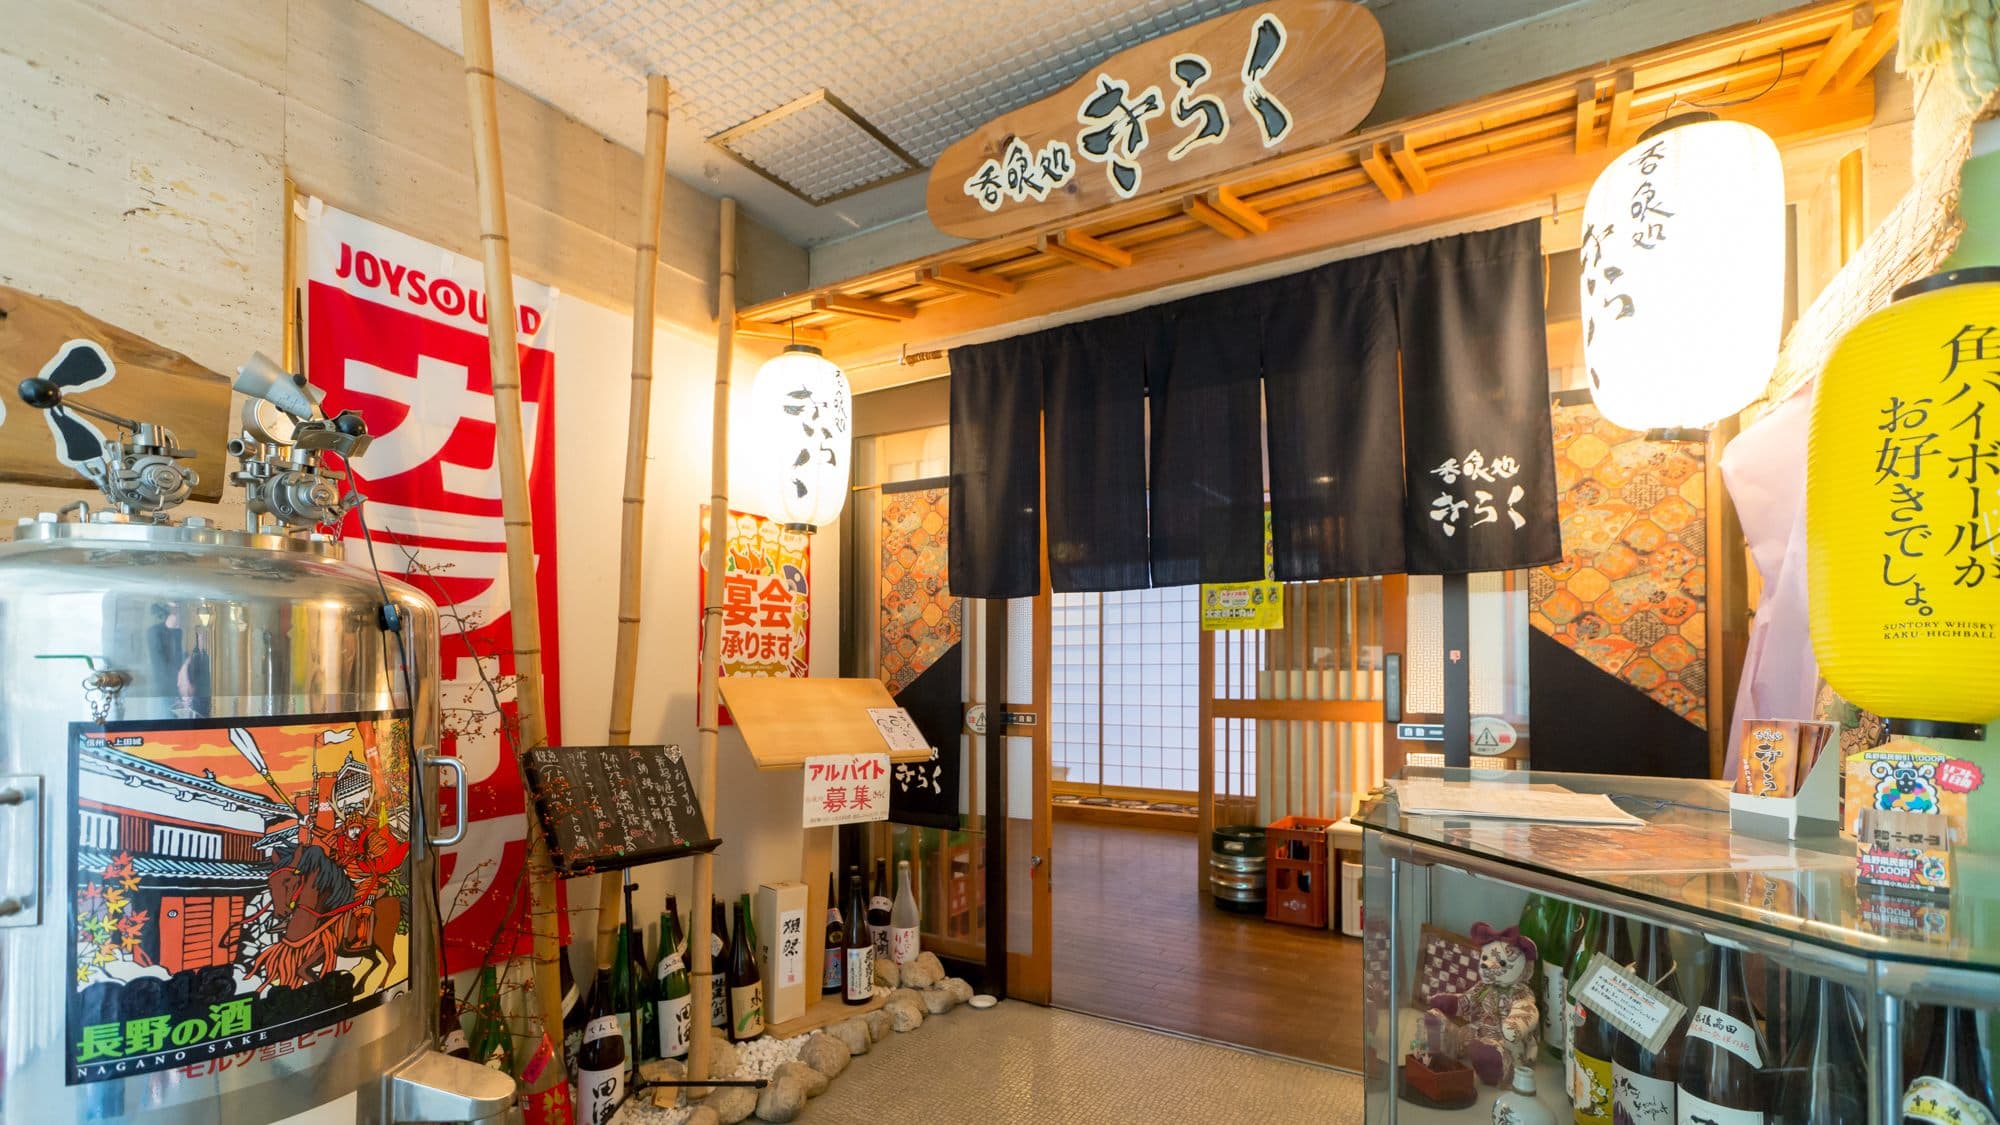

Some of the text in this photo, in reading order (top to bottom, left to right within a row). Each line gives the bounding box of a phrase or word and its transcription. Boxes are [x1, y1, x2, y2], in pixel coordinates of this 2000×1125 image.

[1082, 20, 1287, 193] きらく
[335, 241, 543, 336] JOYSOUD
[1430, 485, 1526, 536] きらく
[1875, 397, 1941, 616] お好きでしょ。
[723, 574, 793, 629] 宴会
[1883, 620, 1997, 631] SUNTORY WHISKY
[722, 629, 792, 660] 承ります
[809, 757, 885, 782] アルバイト
[823, 785, 872, 813] 募集
[76, 998, 254, 1062] 長野の酒
[77, 1031, 269, 1078] NAGANO SAKE
